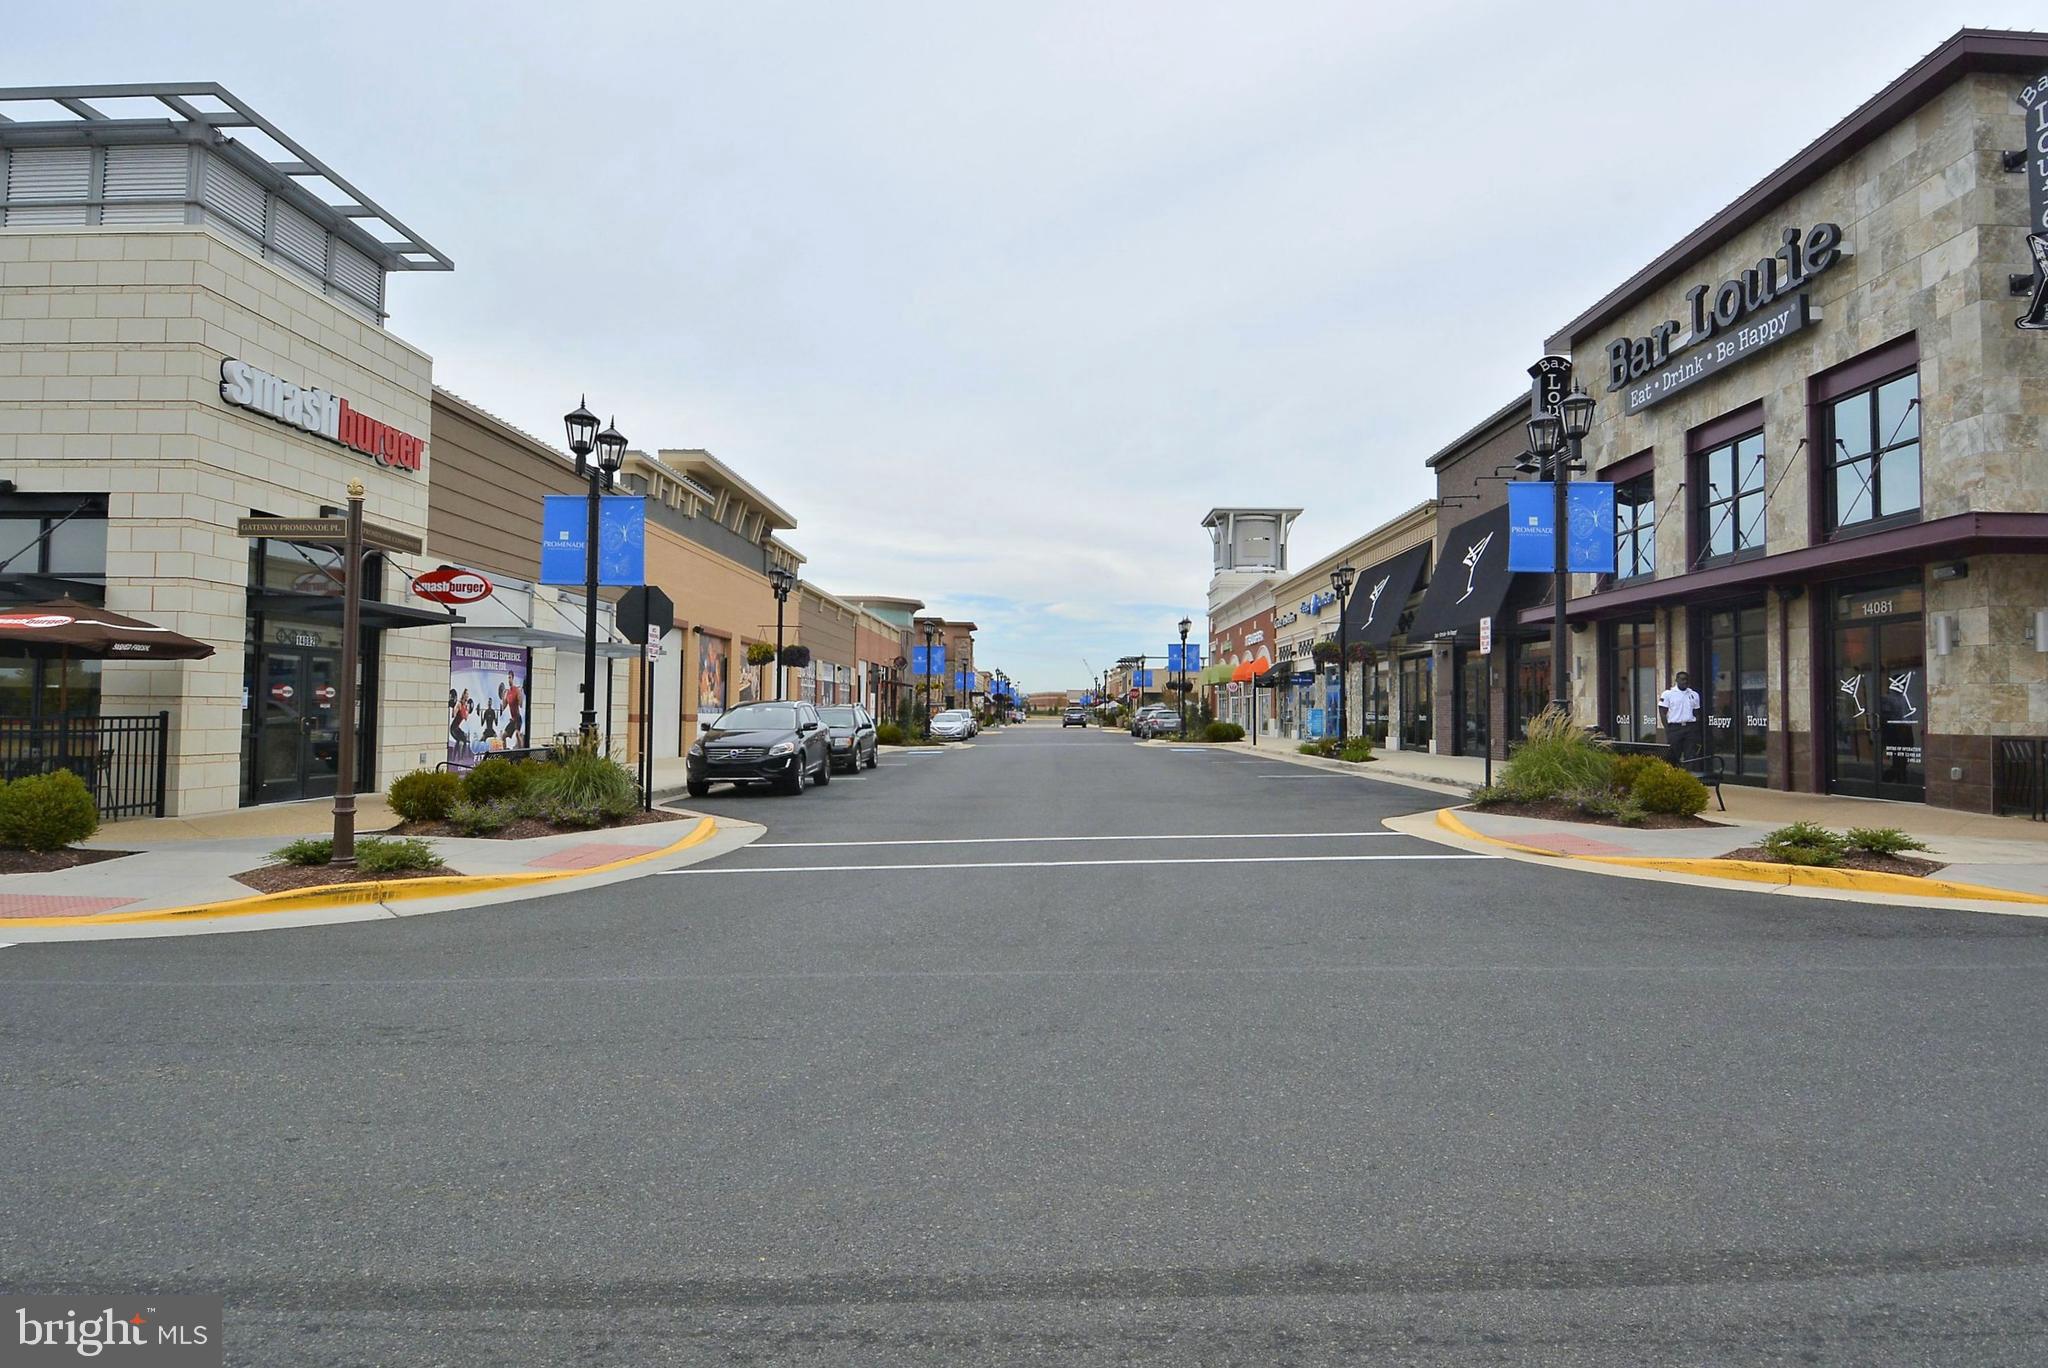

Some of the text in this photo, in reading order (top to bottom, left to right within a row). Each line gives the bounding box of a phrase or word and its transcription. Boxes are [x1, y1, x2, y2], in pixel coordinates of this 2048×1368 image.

[2020, 75, 2048, 107] Ba
[1605, 223, 1842, 392] Bar Louie
[1538, 359, 1570, 372] Bar
[1630, 310, 1789, 408] Eat Drink Be Happy
[1546, 374, 1561, 417] Lou
[220, 358, 425, 471] smashburger
[241, 523, 342, 532] GATEWAY PROMENADE PL.
[1511, 526, 1554, 534] PROMENADE
[543, 540, 585, 549] PROMENADE
[415, 581, 484, 594] smashburger
[1862, 600, 1893, 616] 14081
[1616, 714, 1630, 724] Cold
[1708, 715, 1732, 728] Happy
[1747, 715, 1767, 727] Hour
